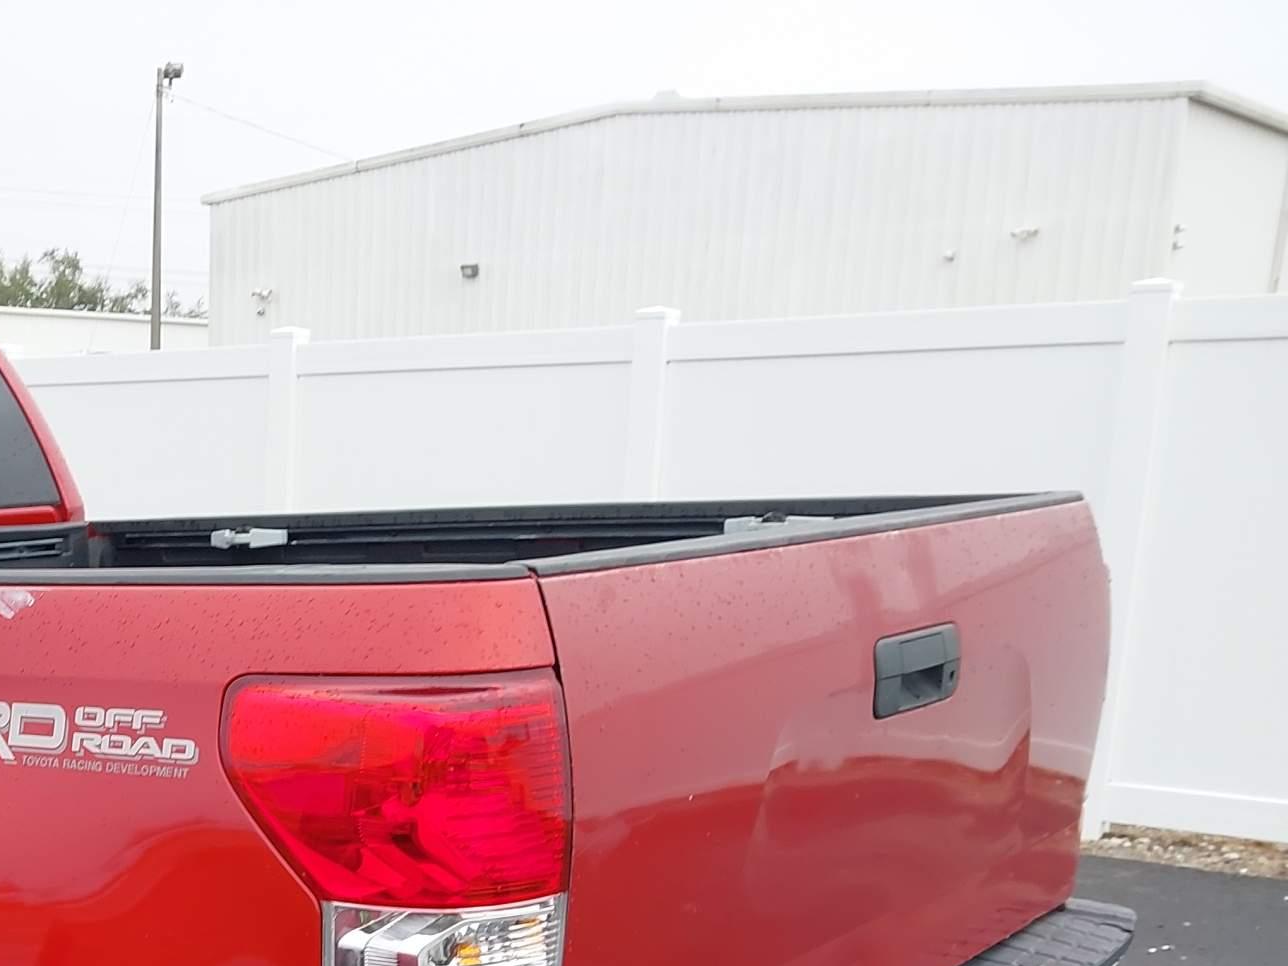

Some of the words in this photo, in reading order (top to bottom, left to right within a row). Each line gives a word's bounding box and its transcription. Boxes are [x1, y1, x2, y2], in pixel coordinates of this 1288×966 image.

[74, 706, 167, 733] OFF
[71, 732, 199, 765] ROAD
[22, 754, 59, 768] TOYOTA
[63, 758, 103, 772] RACING
[105, 762, 190, 779] DEVELOPMENT
